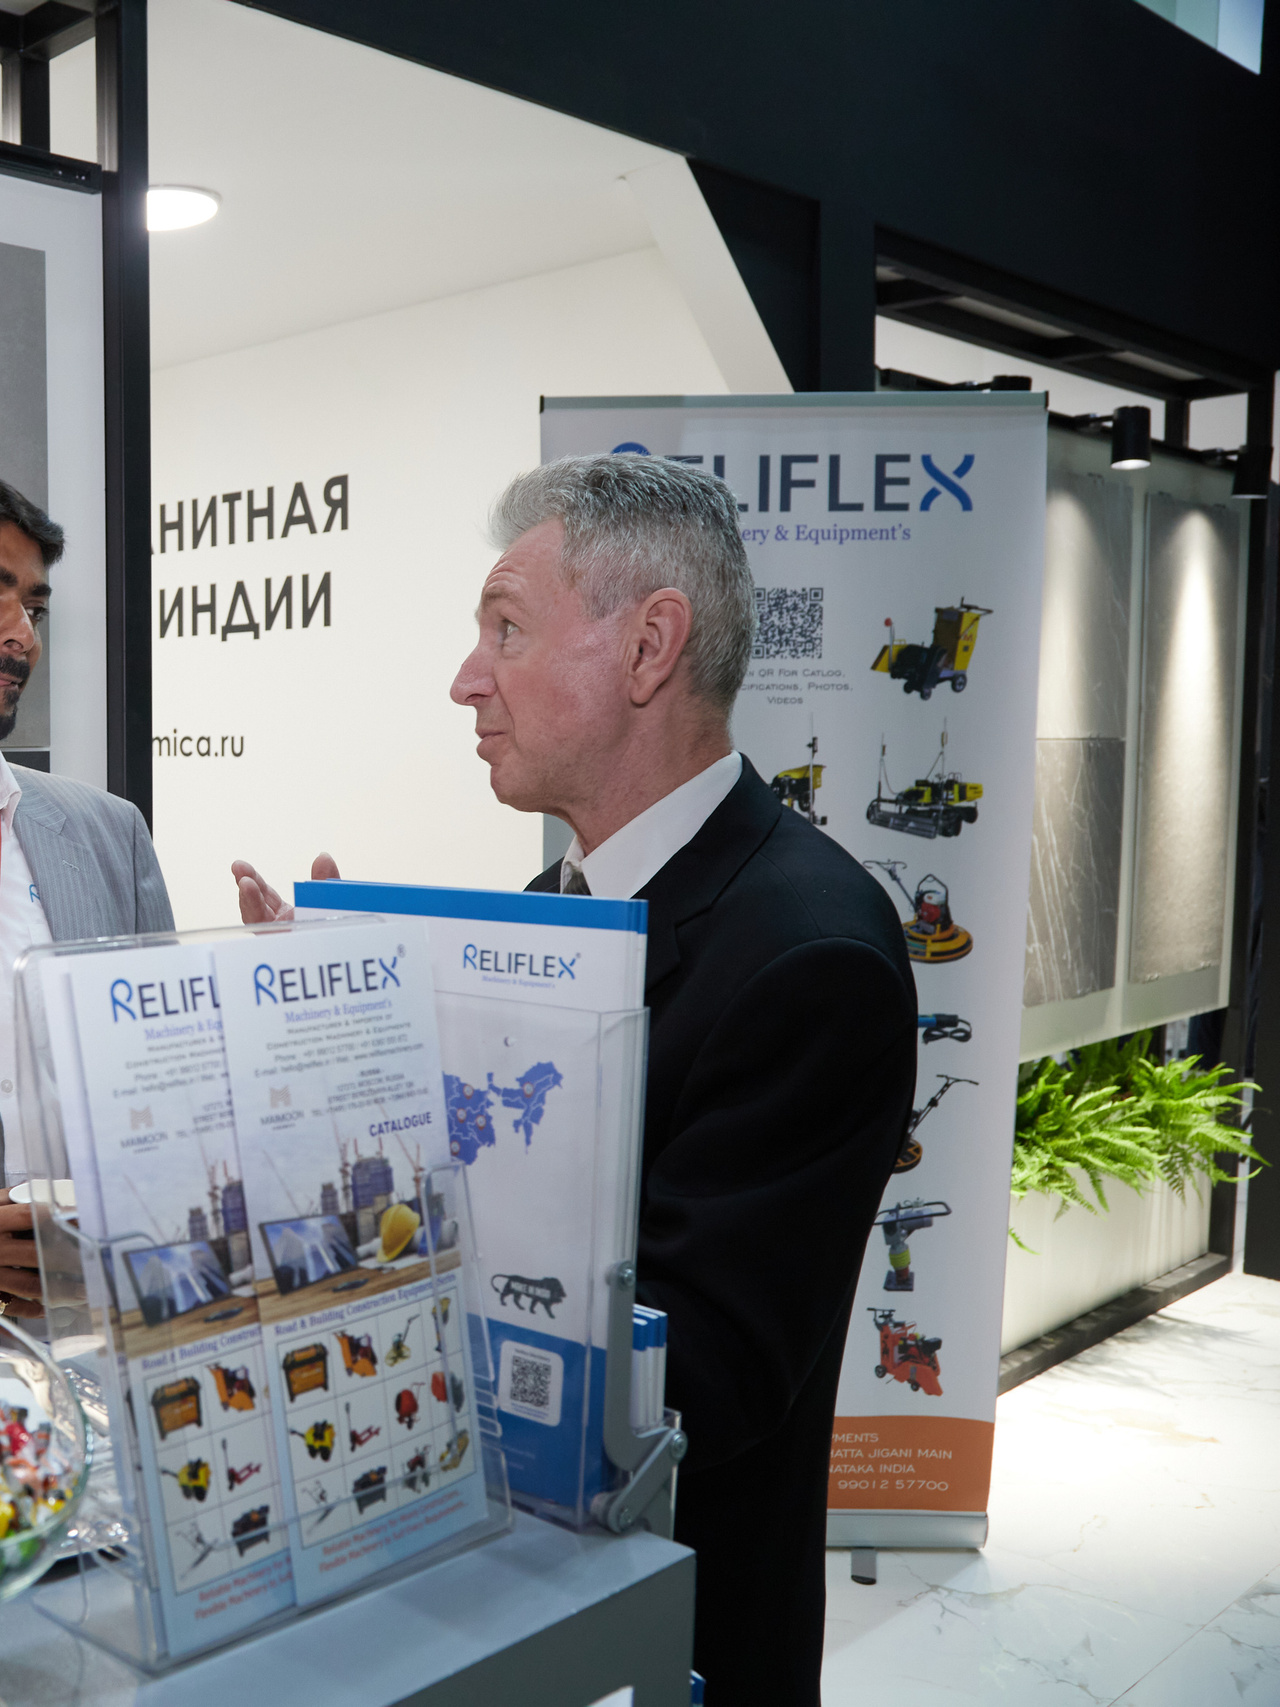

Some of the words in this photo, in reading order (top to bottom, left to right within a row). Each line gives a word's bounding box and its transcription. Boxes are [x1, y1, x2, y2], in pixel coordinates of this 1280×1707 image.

[151, 473, 350, 555] НИТНАЯ
[774, 525, 789, 541] &
[795, 523, 912, 546] Equipment's
[159, 571, 332, 642] ИНДИИ
[758, 668, 775, 678] QR
[152, 728, 245, 757] mica.ru
[285, 1007, 331, 1024] Machinery
[333, 1006, 341, 1017] &
[144, 1023, 194, 1042] Machinery
[369, 1112, 433, 1137] CATALOGUE
[832, 1432, 879, 1443] MENTS
[868, 1448, 913, 1458] JIGANI
[917, 1449, 953, 1460] MAIN
[879, 1464, 916, 1474] INDIA
[837, 1479, 889, 1490] 99012
[895, 1479, 949, 1492] 57700
